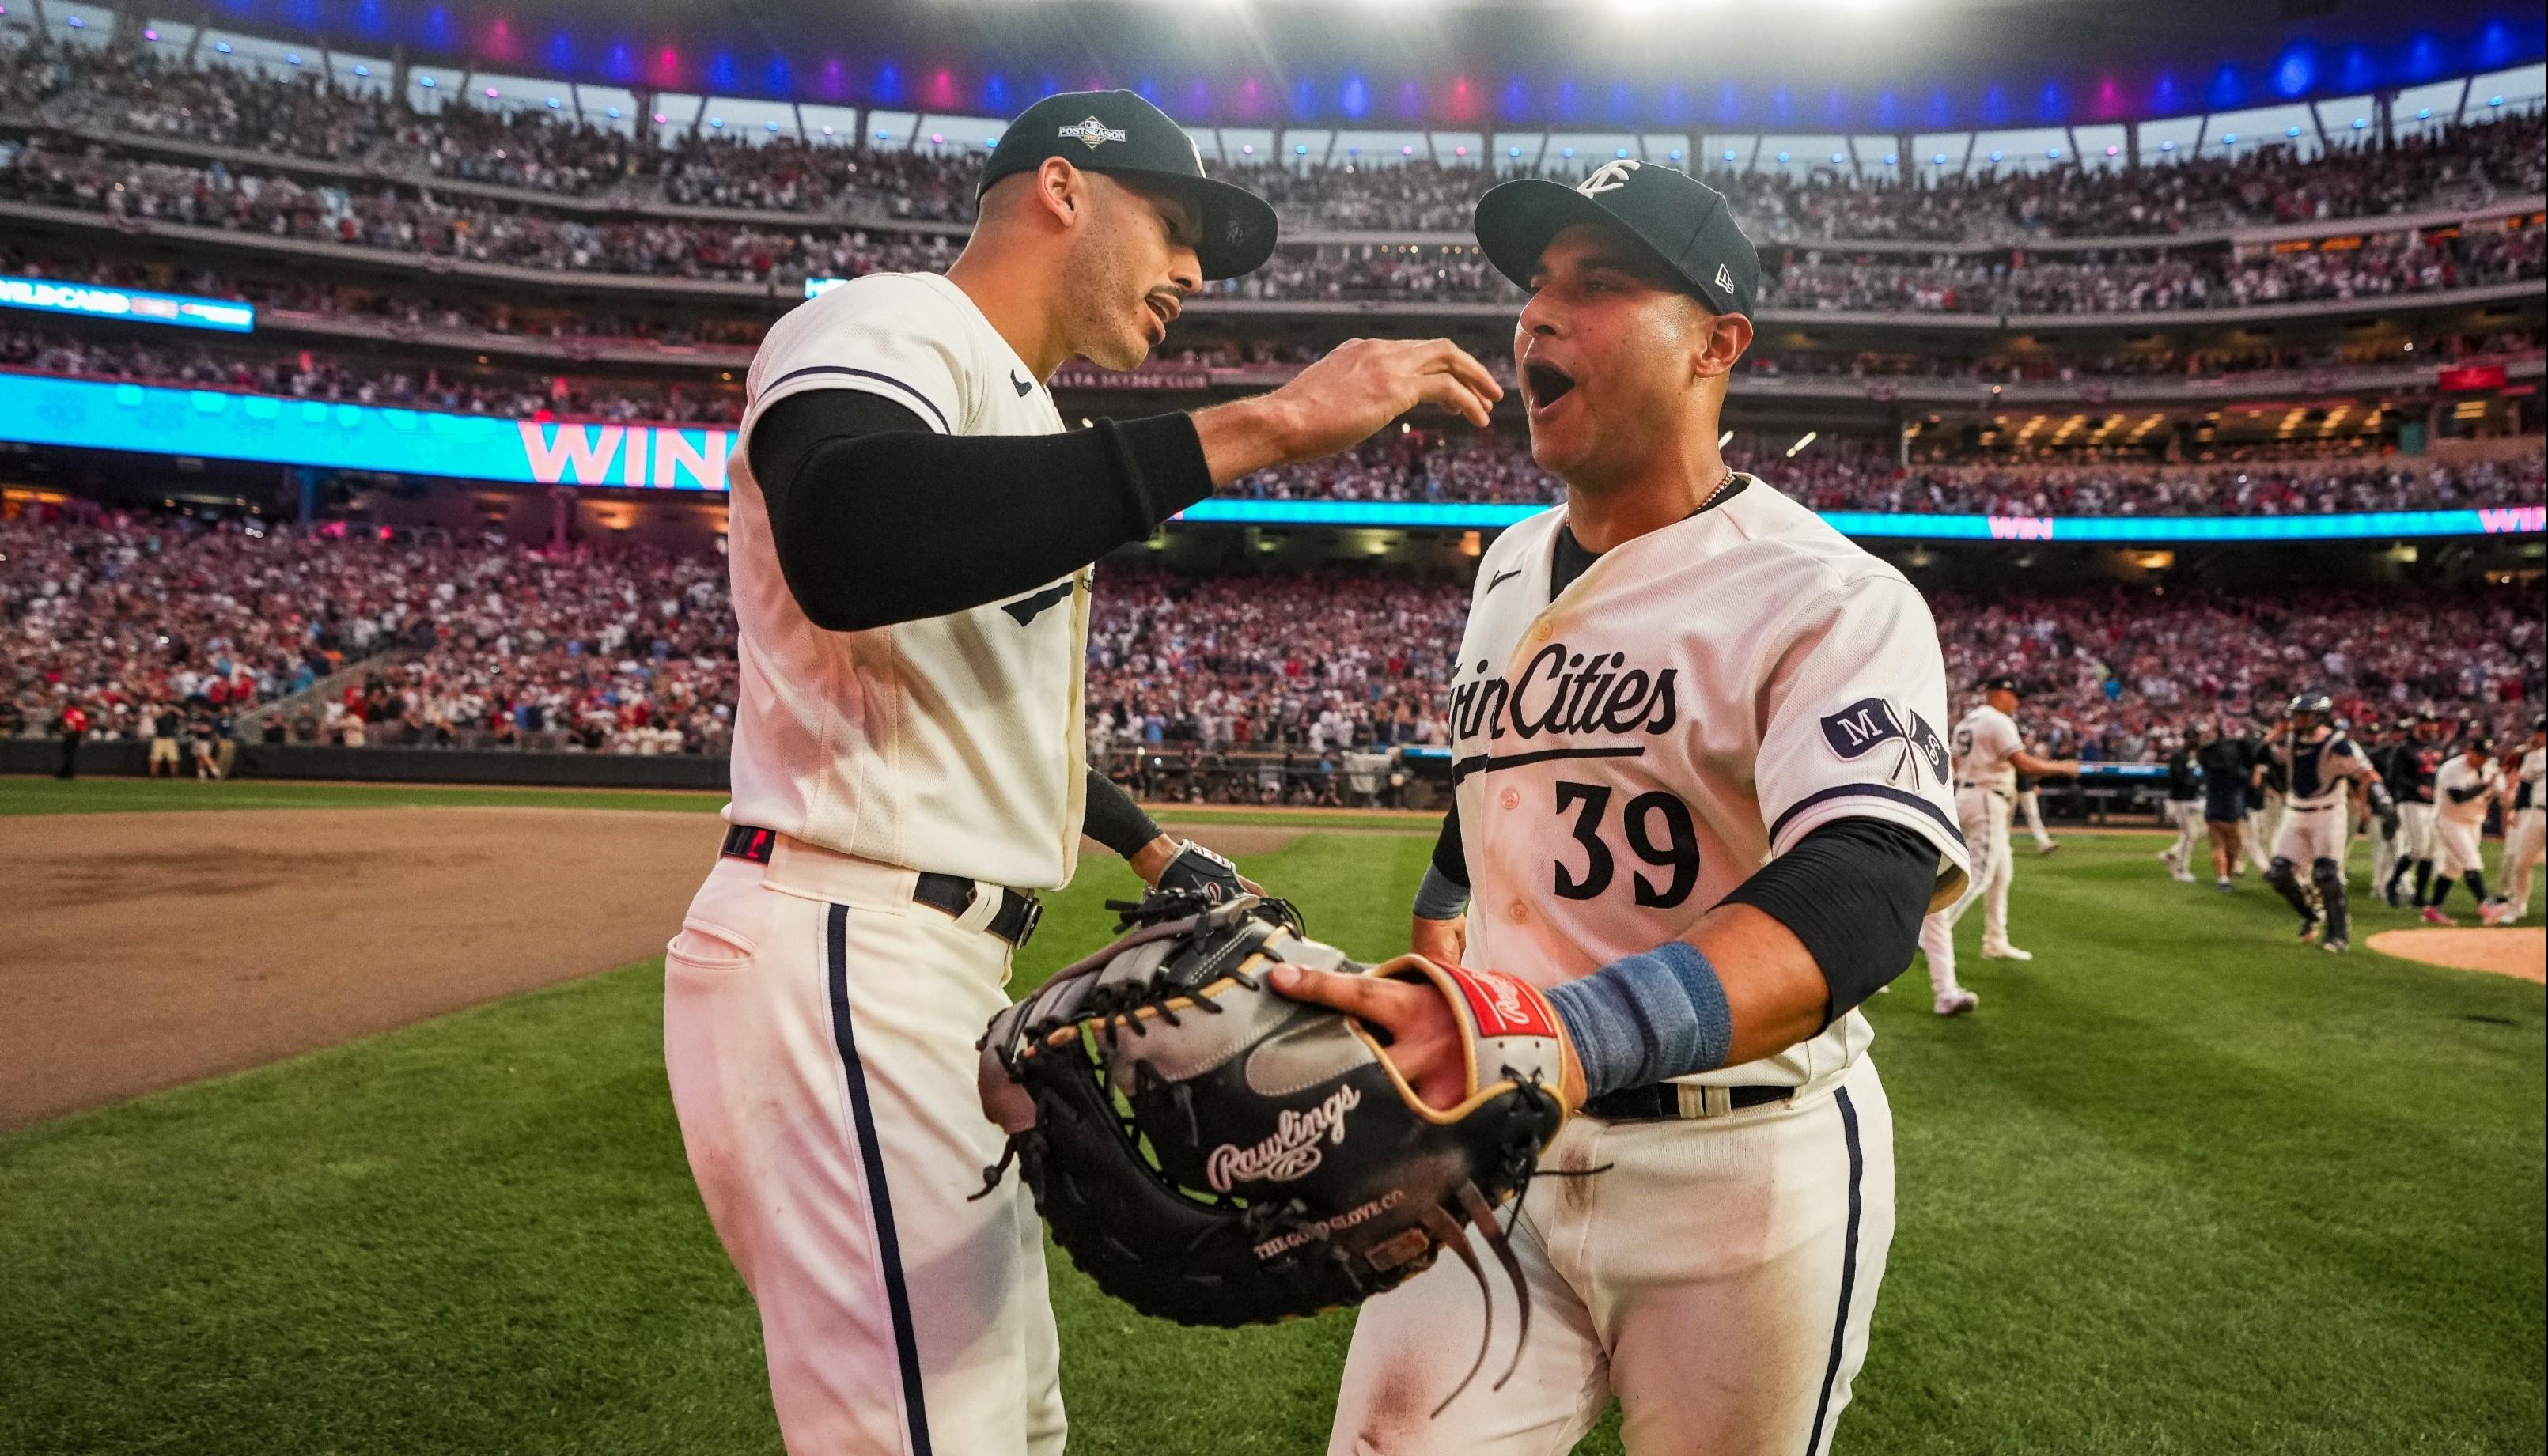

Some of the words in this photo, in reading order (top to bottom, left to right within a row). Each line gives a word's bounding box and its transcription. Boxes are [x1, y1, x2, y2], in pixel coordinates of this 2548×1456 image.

[1059, 127, 1125, 140] POSTSEASON
[518, 421, 726, 490] WIN
[1988, 516, 2054, 540] WIN
[1510, 643, 1679, 739] Cities
[1837, 709, 1884, 747] M
[1554, 781, 1700, 909] 39
[1206, 1084, 1361, 1192] Rawlings
[1253, 1236, 1289, 1260] THE
[1285, 1220, 1330, 1246] GOD
